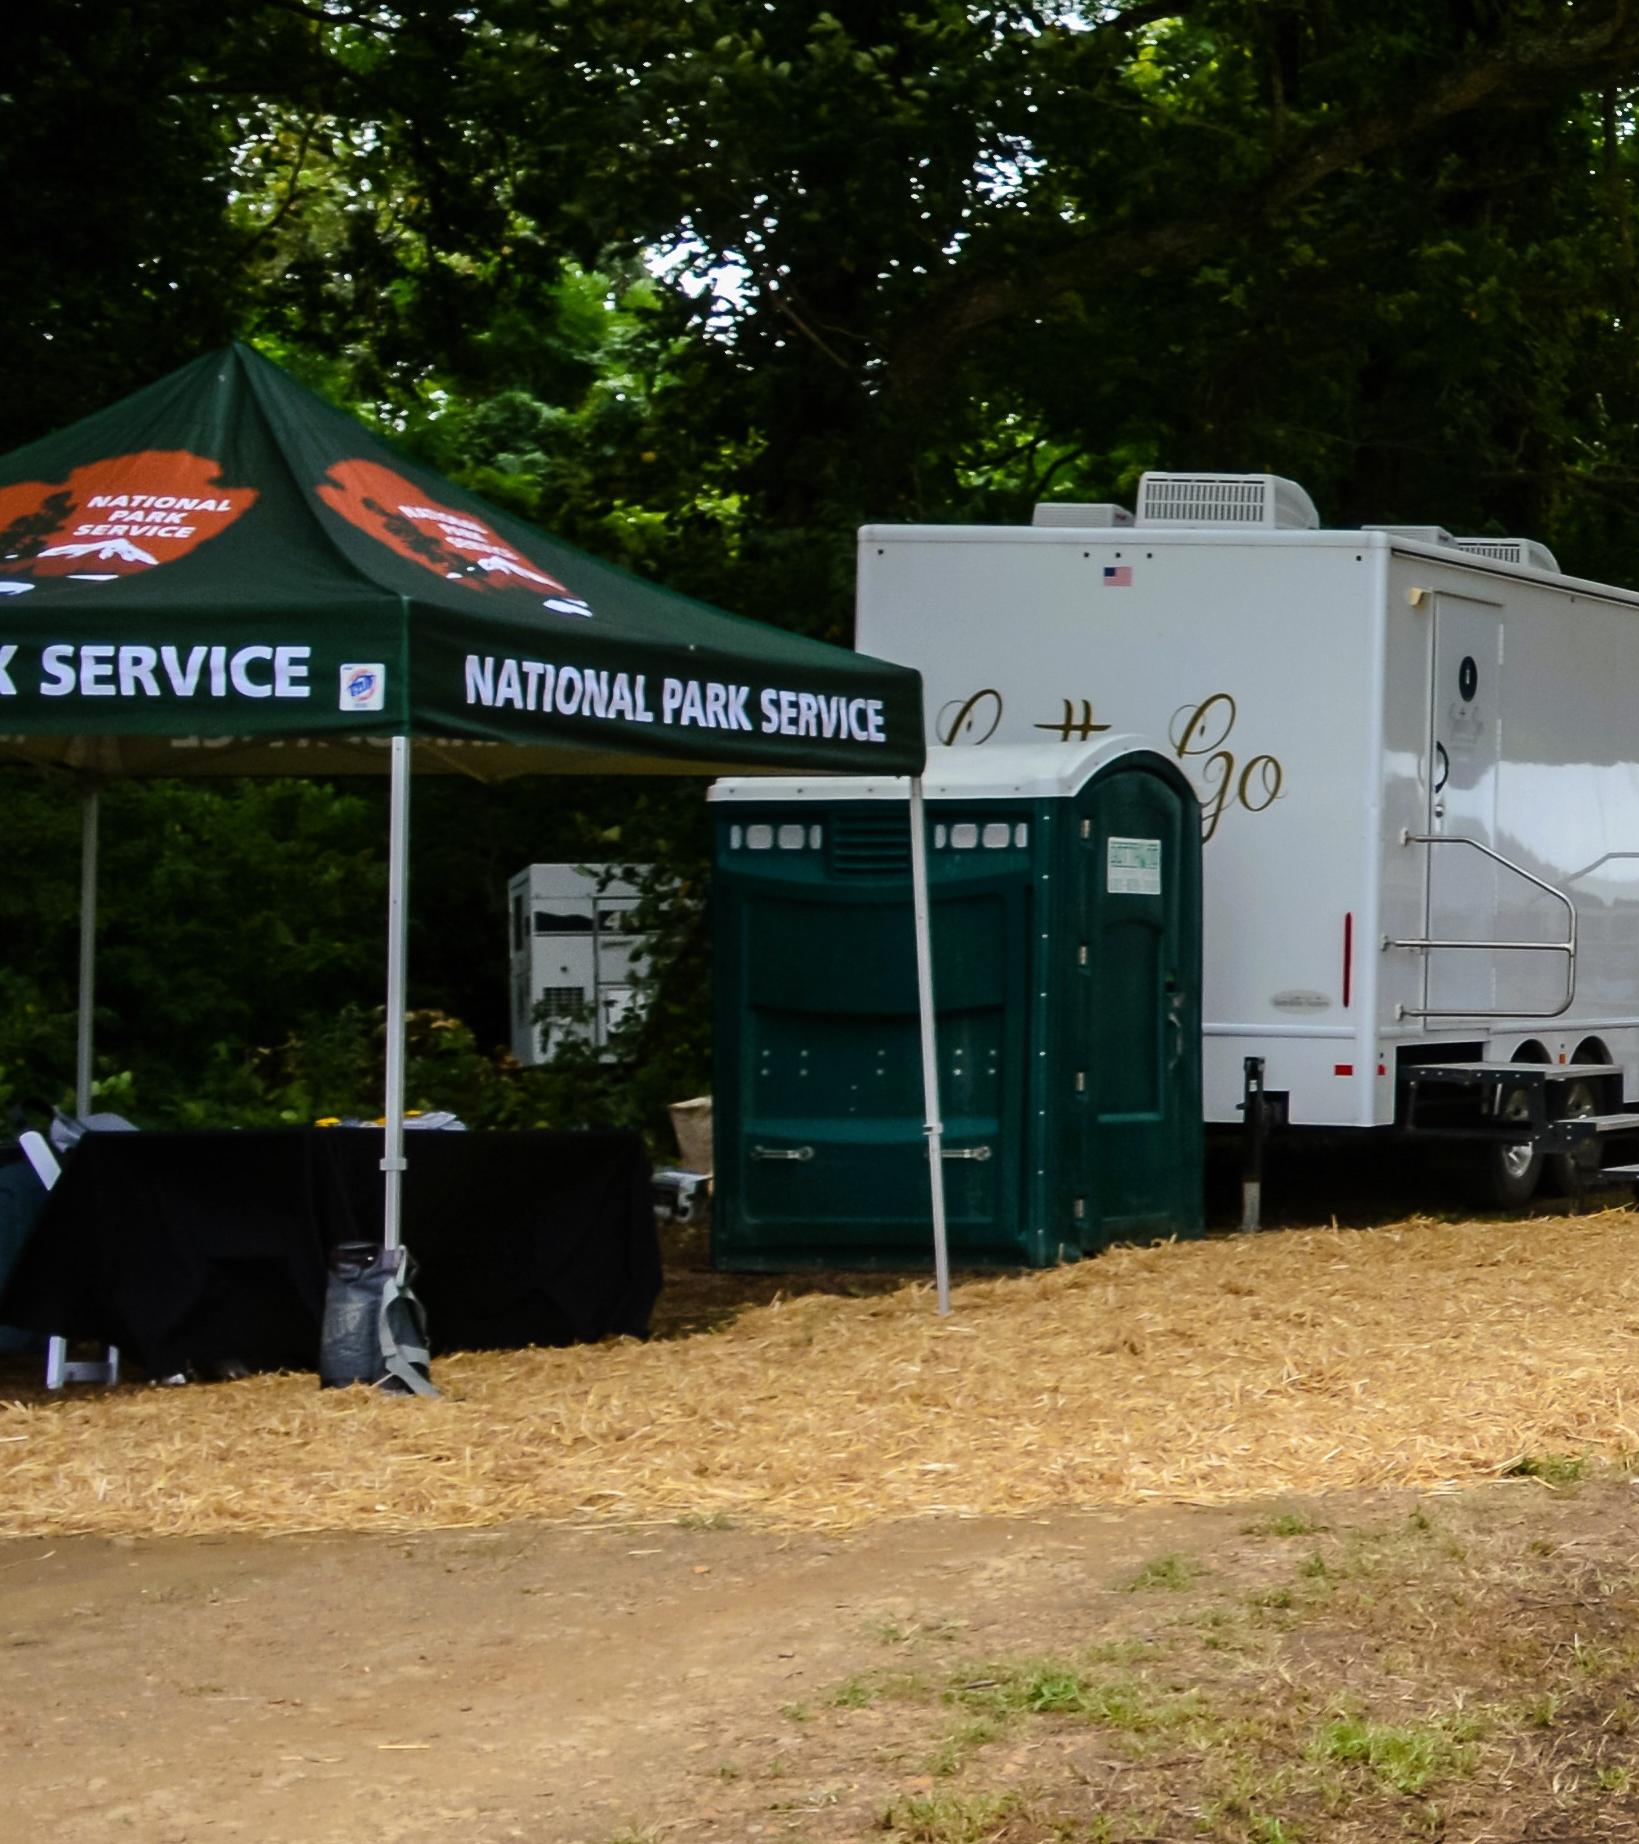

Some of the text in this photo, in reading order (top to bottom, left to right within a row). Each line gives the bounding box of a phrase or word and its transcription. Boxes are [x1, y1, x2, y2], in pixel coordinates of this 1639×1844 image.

[87, 495, 232, 512] NATIONAL
[107, 510, 188, 524] PARK
[73, 524, 197, 538] SERVICE
[40, 644, 311, 697] SERVICE
[464, 654, 654, 723] NATIONAL
[663, 678, 753, 731] PARK
[760, 688, 887, 742] SERVICE
